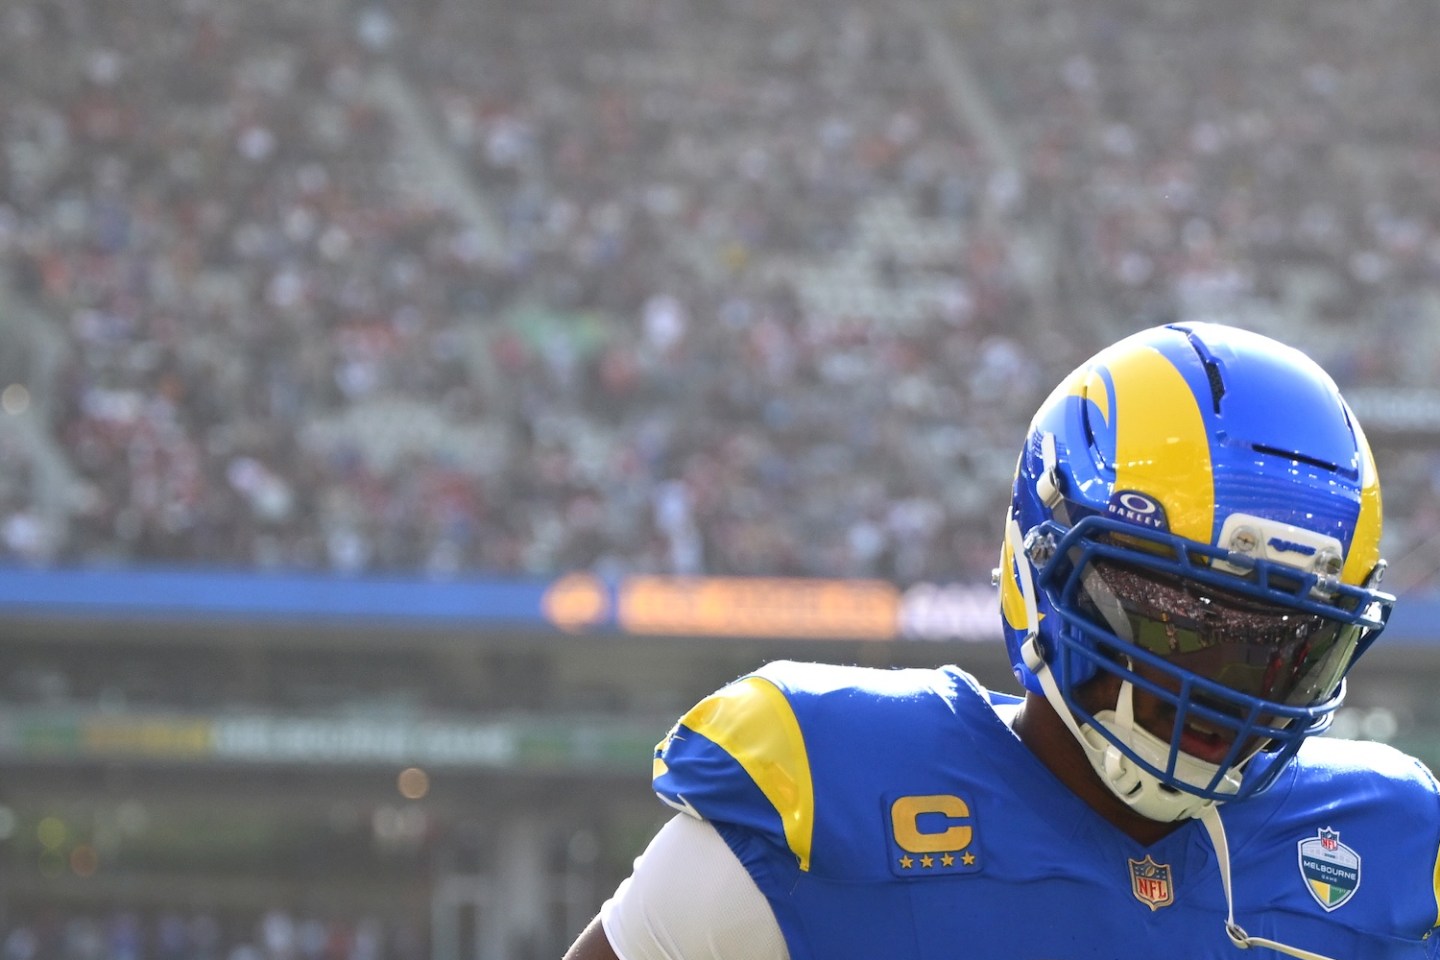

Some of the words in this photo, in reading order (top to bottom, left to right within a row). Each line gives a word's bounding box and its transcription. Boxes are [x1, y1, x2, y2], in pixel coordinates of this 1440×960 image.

[1108, 504, 1161, 528] OAKLEY
[891, 794, 973, 853] C
[1303, 860, 1357, 881] MELBOURNE
[1137, 878, 1167, 899] NFL
